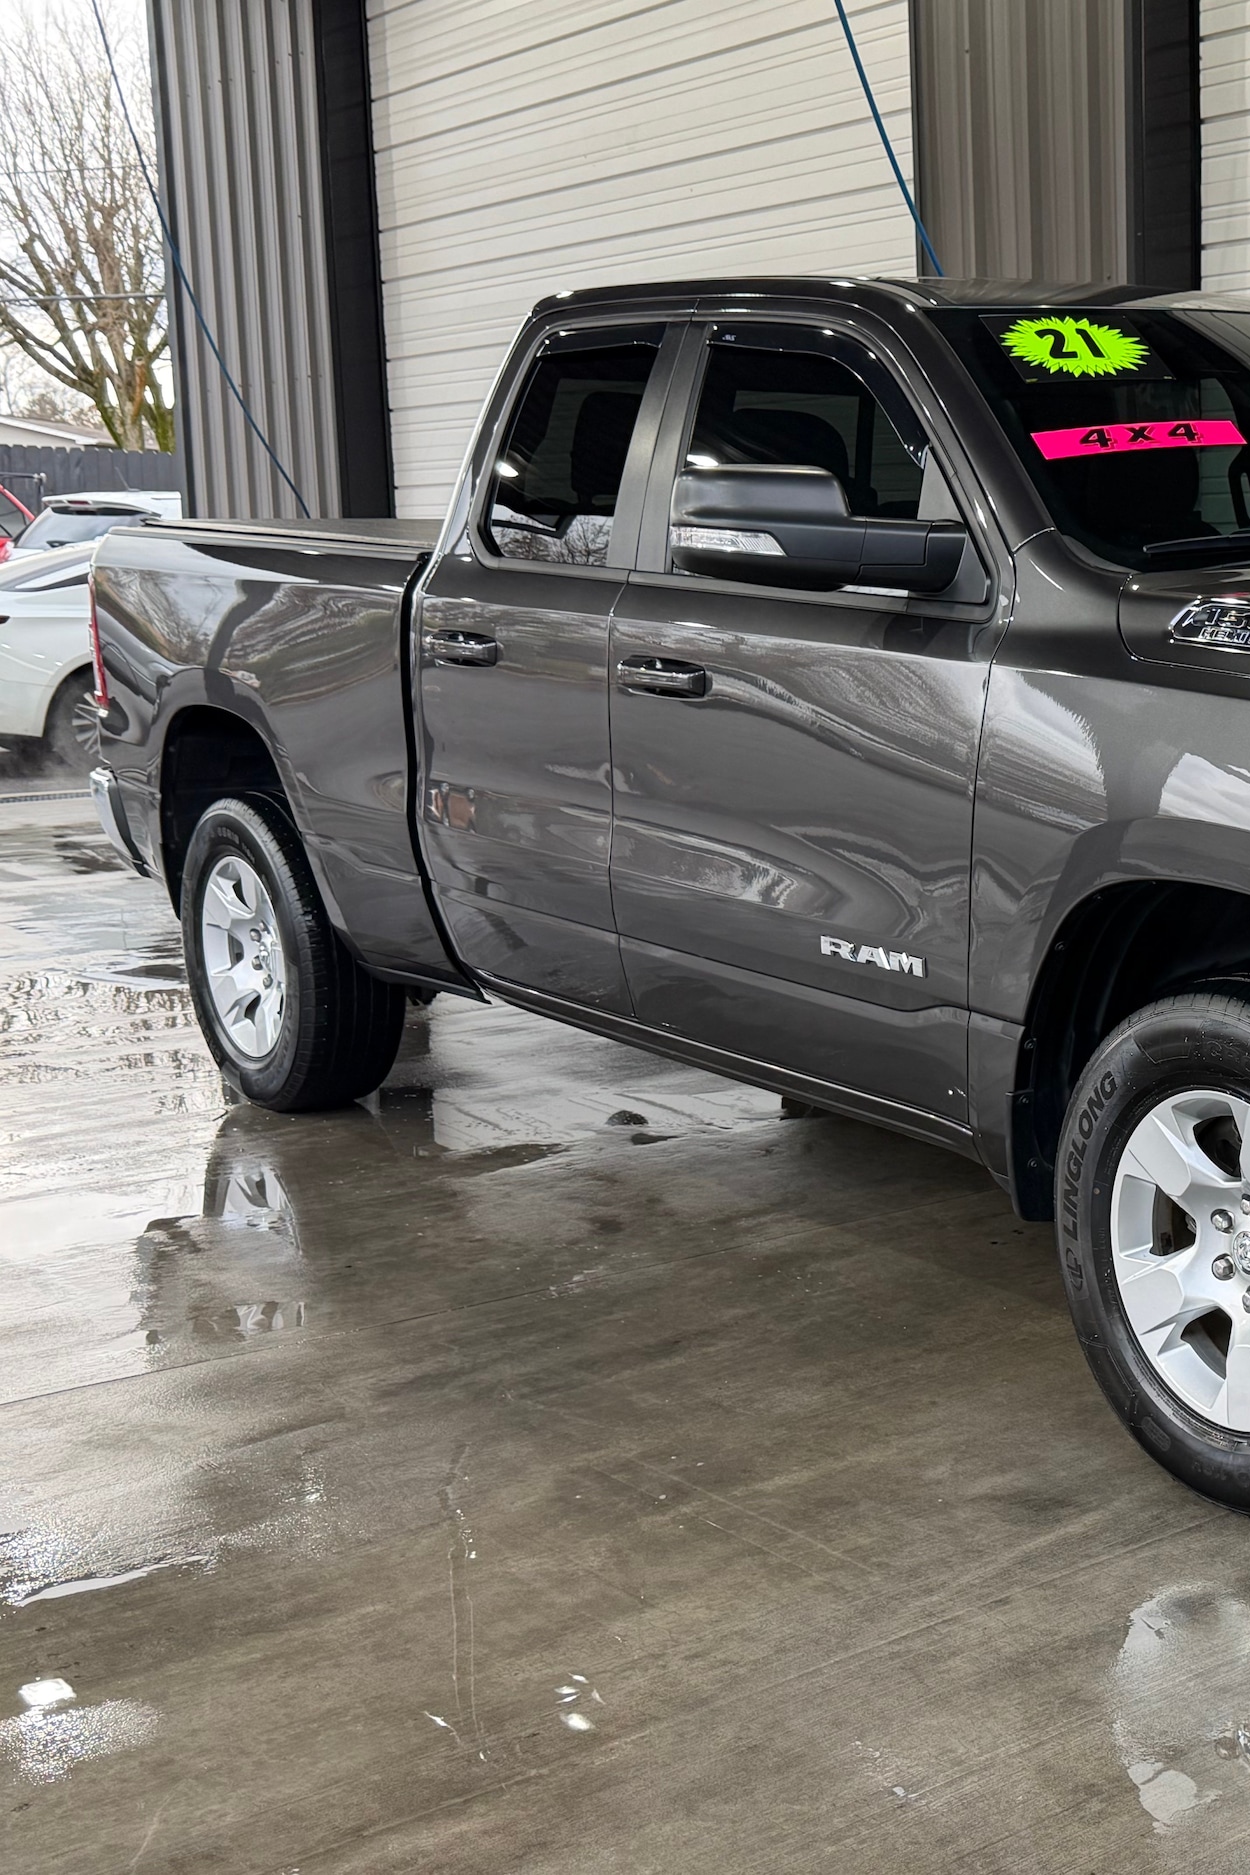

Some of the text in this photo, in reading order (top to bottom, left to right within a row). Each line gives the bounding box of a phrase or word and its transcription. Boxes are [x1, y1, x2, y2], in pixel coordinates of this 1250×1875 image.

[1034, 327, 1106, 360] 21
[1200, 626, 1247, 645] HEMI
[820, 934, 928, 979] RAM
[1063, 1070, 1119, 1241] LINGLONG
